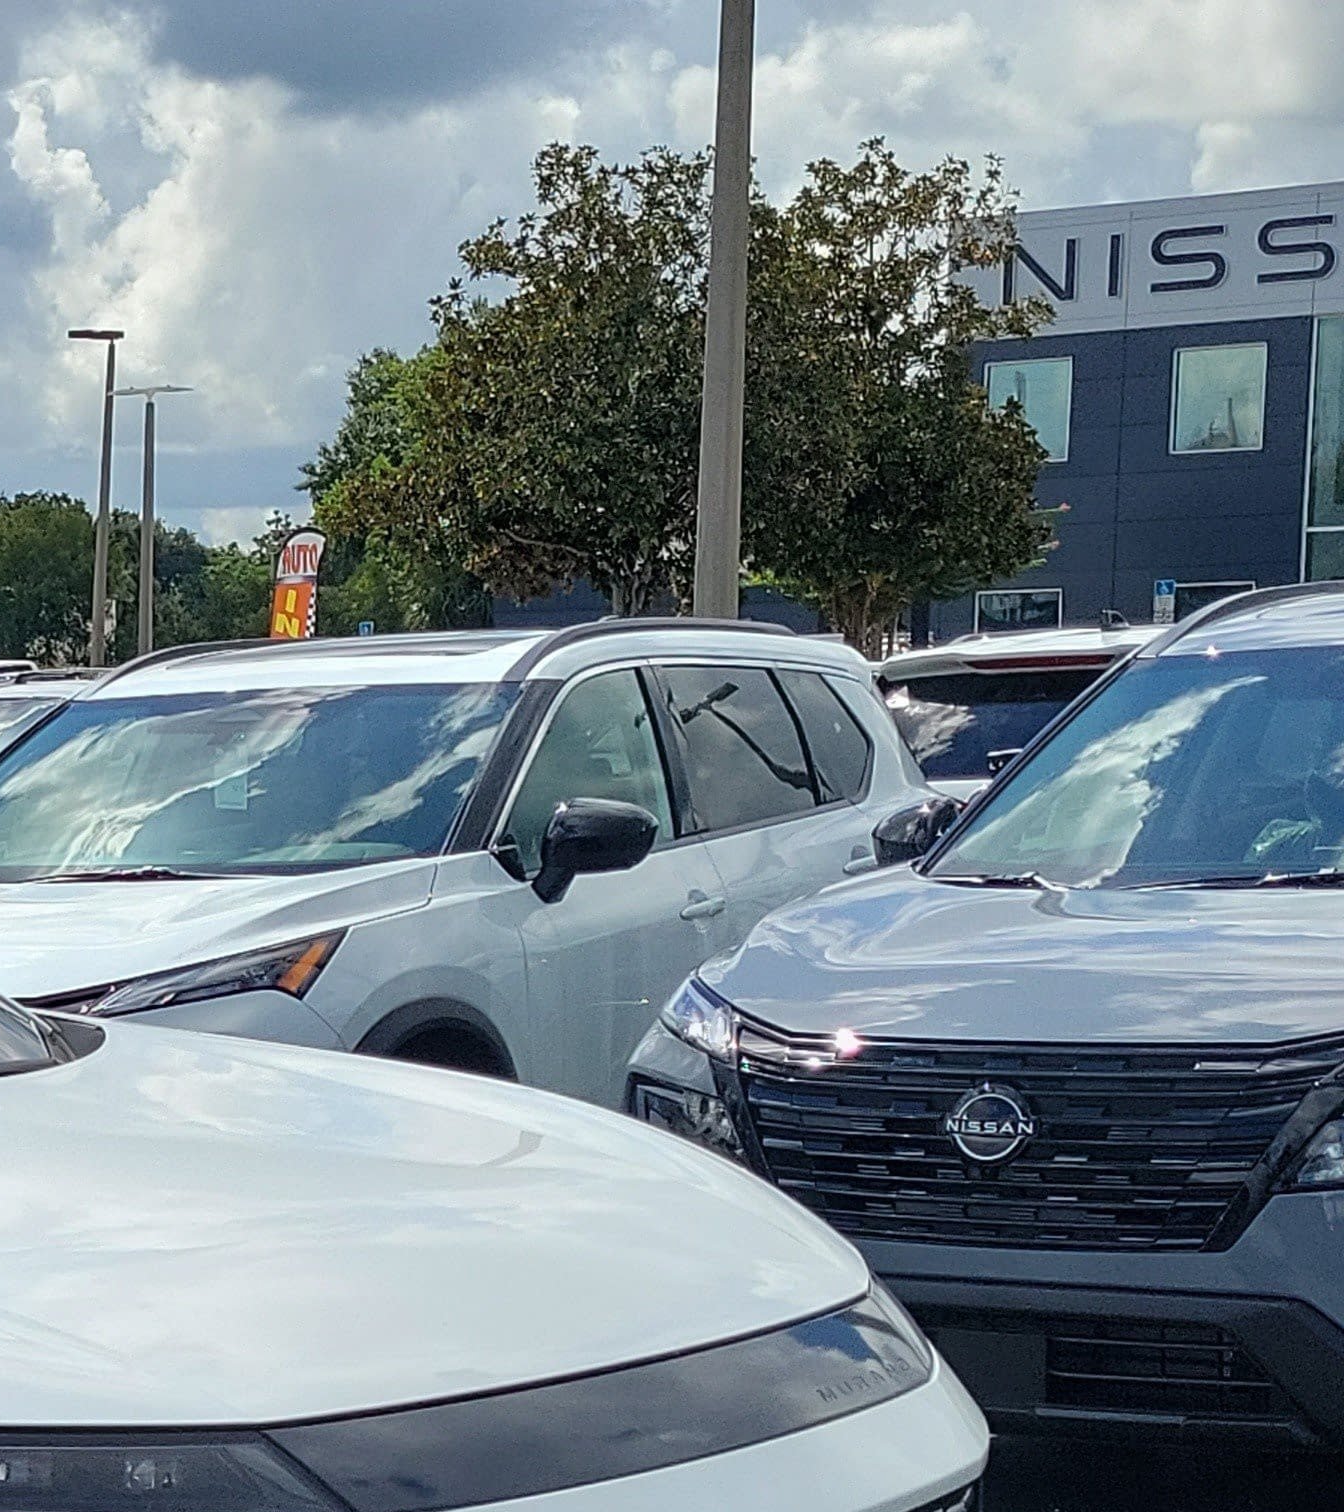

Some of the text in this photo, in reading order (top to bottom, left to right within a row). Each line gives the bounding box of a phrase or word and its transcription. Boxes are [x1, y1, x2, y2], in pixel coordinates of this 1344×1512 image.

[1002, 213, 1337, 306] NISS
[282, 544, 318, 574] AUTO
[945, 1118, 1034, 1135] NISSAN
[816, 1358, 911, 1403] MURANO
